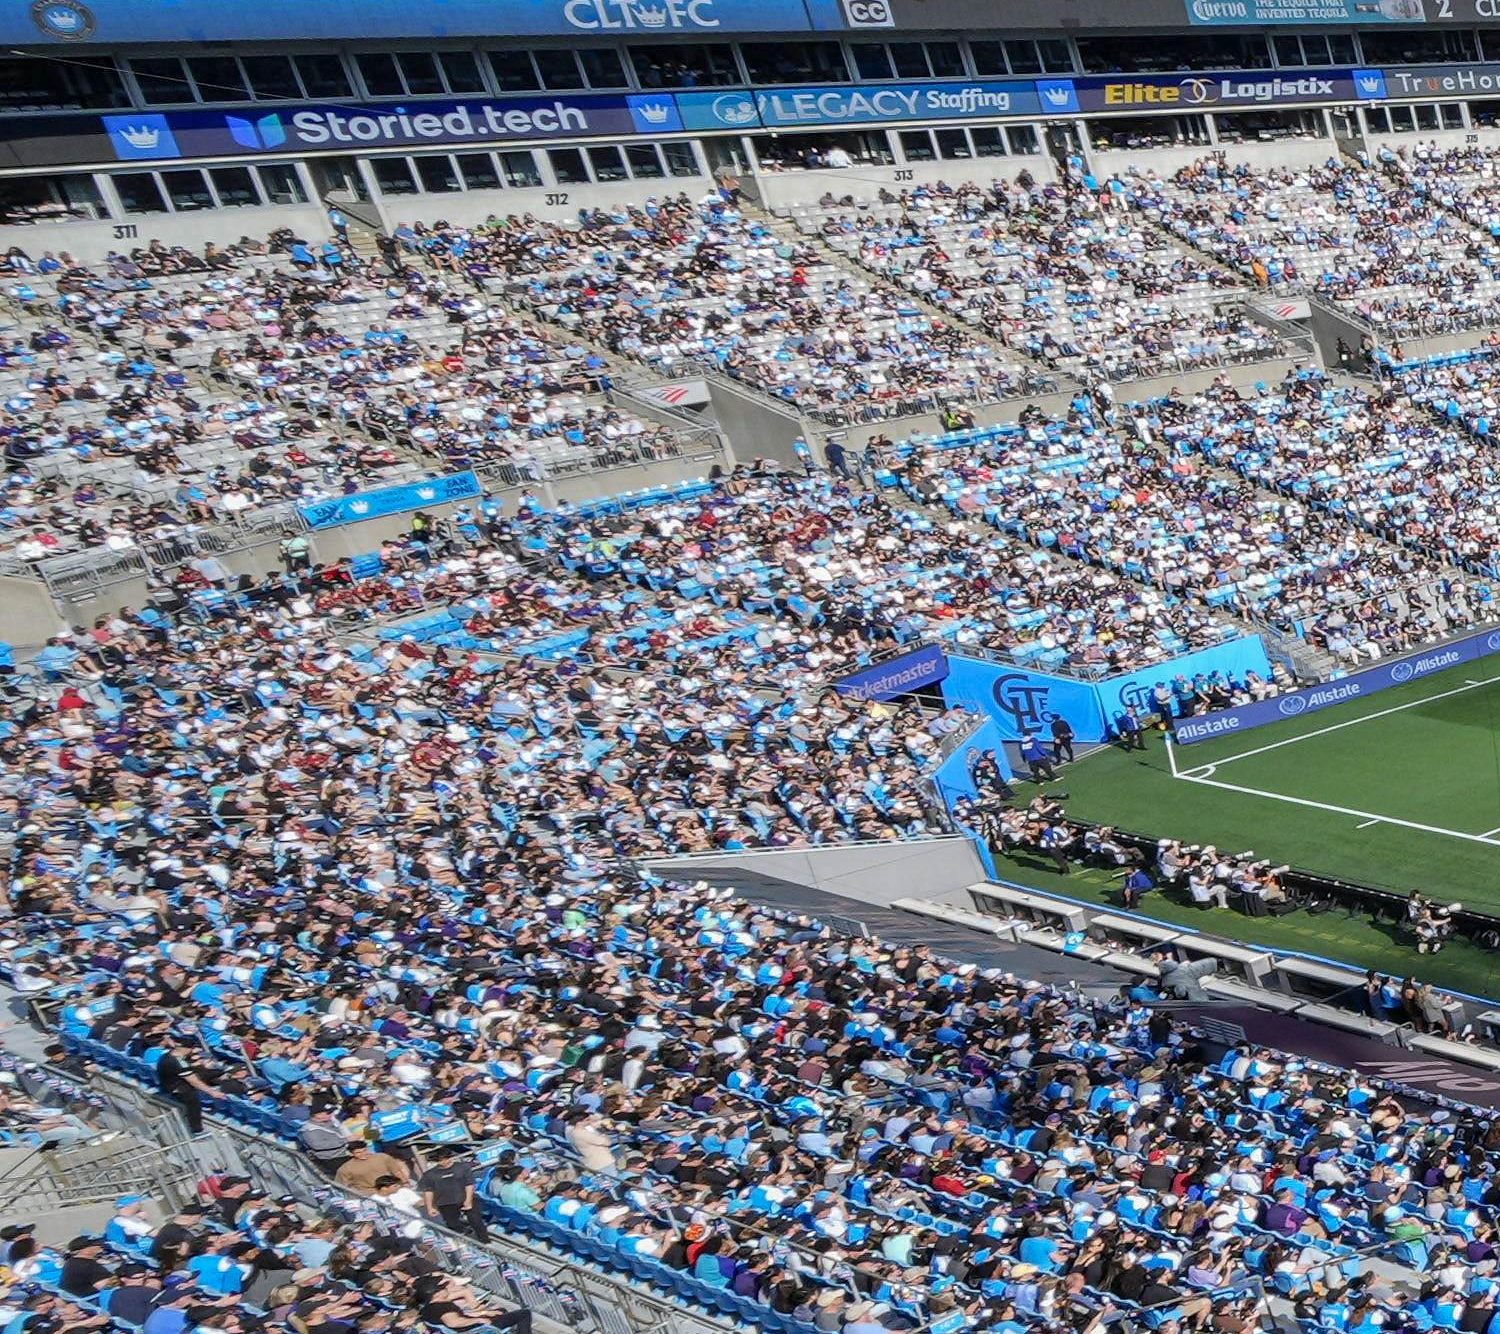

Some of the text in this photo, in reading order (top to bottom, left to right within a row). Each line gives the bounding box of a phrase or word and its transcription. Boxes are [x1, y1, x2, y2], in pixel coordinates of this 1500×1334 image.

[1255, 8, 1349, 20] INVENTED TEQUILA
[771, 87, 1010, 121] LEGACY Staffing
[1104, 76, 1334, 105] Elite Logistix
[292, 101, 588, 143] Storied.tech
[893, 169, 914, 181] 313
[544, 194, 569, 207] 312
[113, 223, 138, 240] 311
[1411, 650, 1459, 678] Allstate
[848, 658, 939, 700] icketmaster
[1306, 680, 1361, 710] Allstate
[1174, 714, 1240, 742] Allstate
